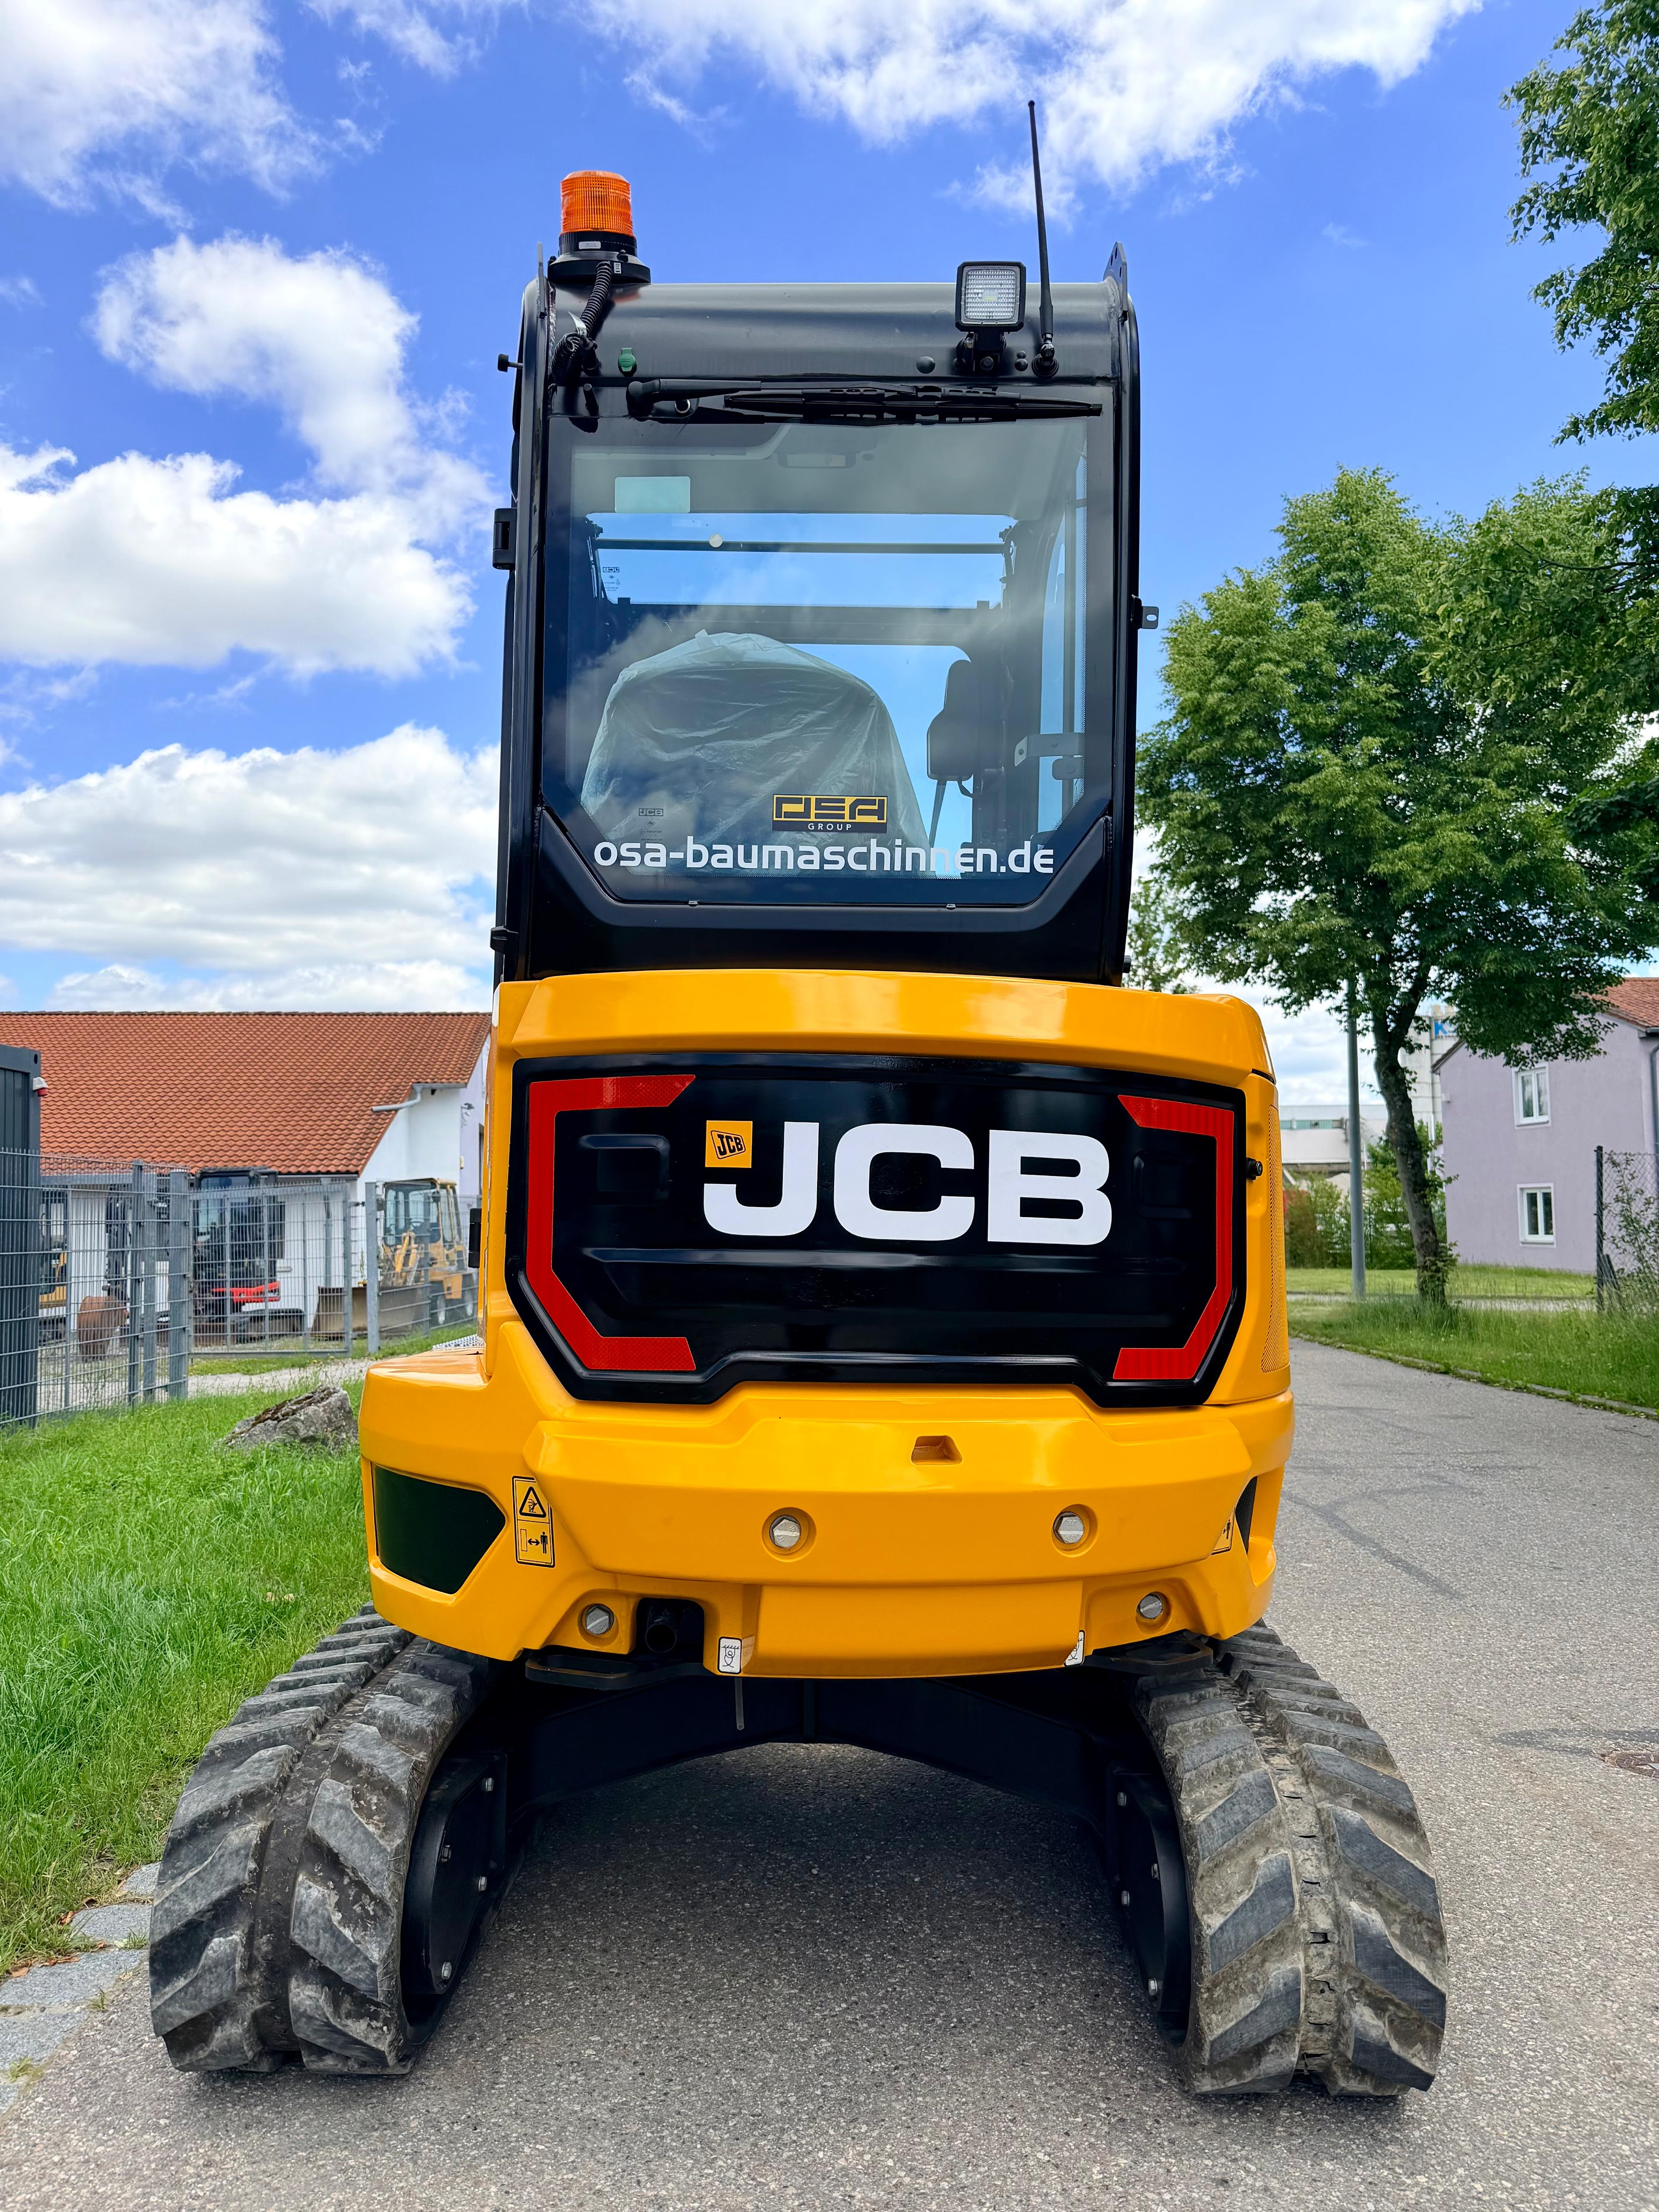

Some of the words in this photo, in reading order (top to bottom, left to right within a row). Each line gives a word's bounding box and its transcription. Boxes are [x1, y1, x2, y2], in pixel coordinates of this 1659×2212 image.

[808, 823, 852, 831] GROUP
[594, 836, 1054, 873] osa-baumaschinnen.de
[717, 1133, 744, 1156] JCB
[704, 1121, 1112, 1245] JCB
